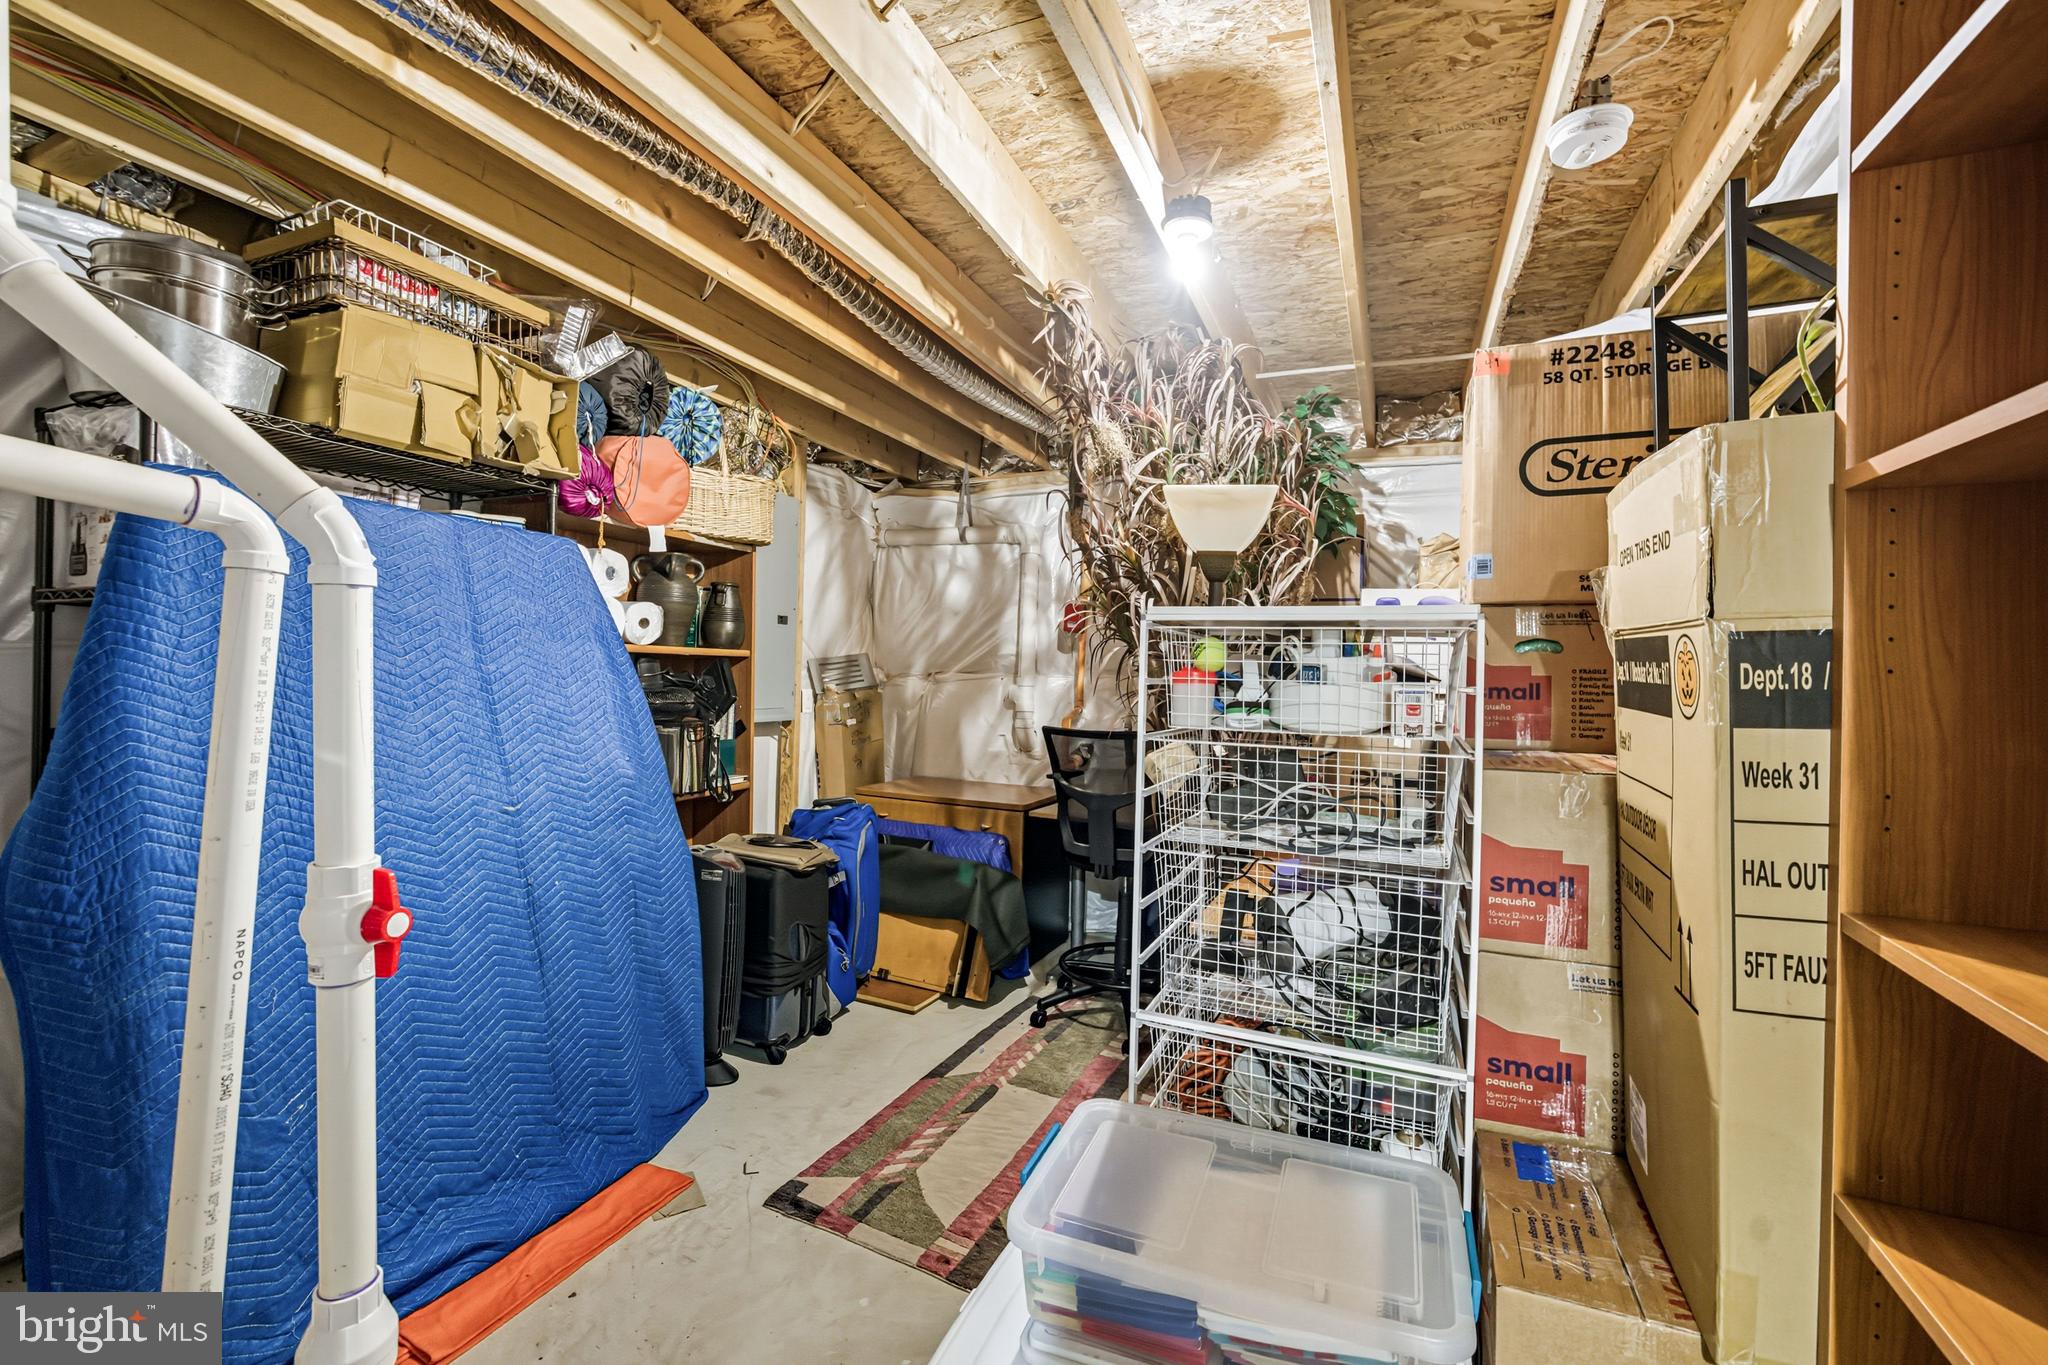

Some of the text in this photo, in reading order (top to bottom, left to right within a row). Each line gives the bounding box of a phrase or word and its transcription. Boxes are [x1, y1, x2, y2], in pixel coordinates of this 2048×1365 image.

[1550, 340, 1636, 366] #2248
[1543, 371, 1564, 385] 58
[1570, 368, 1598, 383] QT.
[1604, 358, 1692, 379] STORGE
[1546, 445, 1655, 483] Ster
[1620, 530, 1671, 567] OPEN THIS END
[1484, 682, 1541, 701] mall
[1740, 661, 1813, 697] Dept.18
[1741, 761, 1820, 790] Week 31
[1489, 875, 1575, 899] small
[1742, 859, 1782, 888] HAL
[1488, 896, 1536, 908] pequeño
[231, 928, 248, 981] NAPCO
[1744, 951, 1777, 980] 5FT
[1485, 1078, 1533, 1091] pequeño
[1487, 1057, 1572, 1086] small
